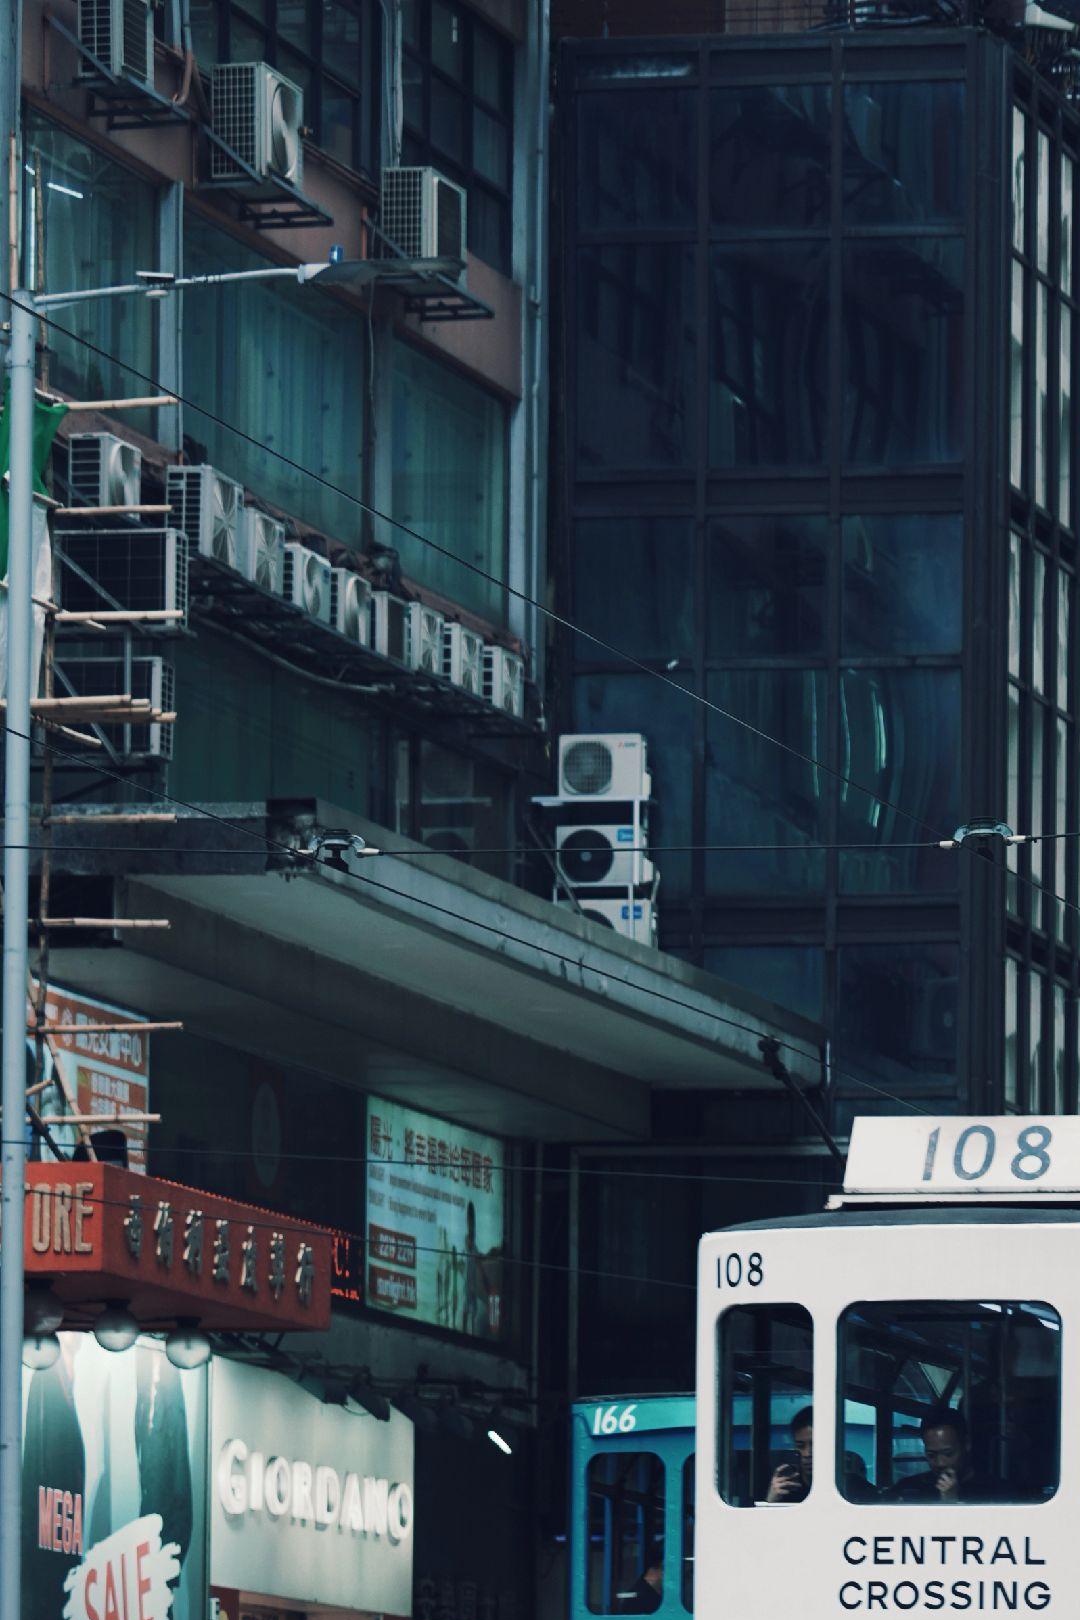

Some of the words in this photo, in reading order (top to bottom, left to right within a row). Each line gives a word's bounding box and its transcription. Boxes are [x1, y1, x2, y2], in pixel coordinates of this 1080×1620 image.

[922, 1125, 1053, 1182] 108
[716, 1252, 764, 1288] 108
[593, 1404, 637, 1435] 166
[219, 1438, 414, 1541] GIORDANO
[38, 1485, 83, 1556] MEGA
[842, 1536, 1046, 1566] CENTRAL
[838, 1580, 1052, 1611] CROSSING
